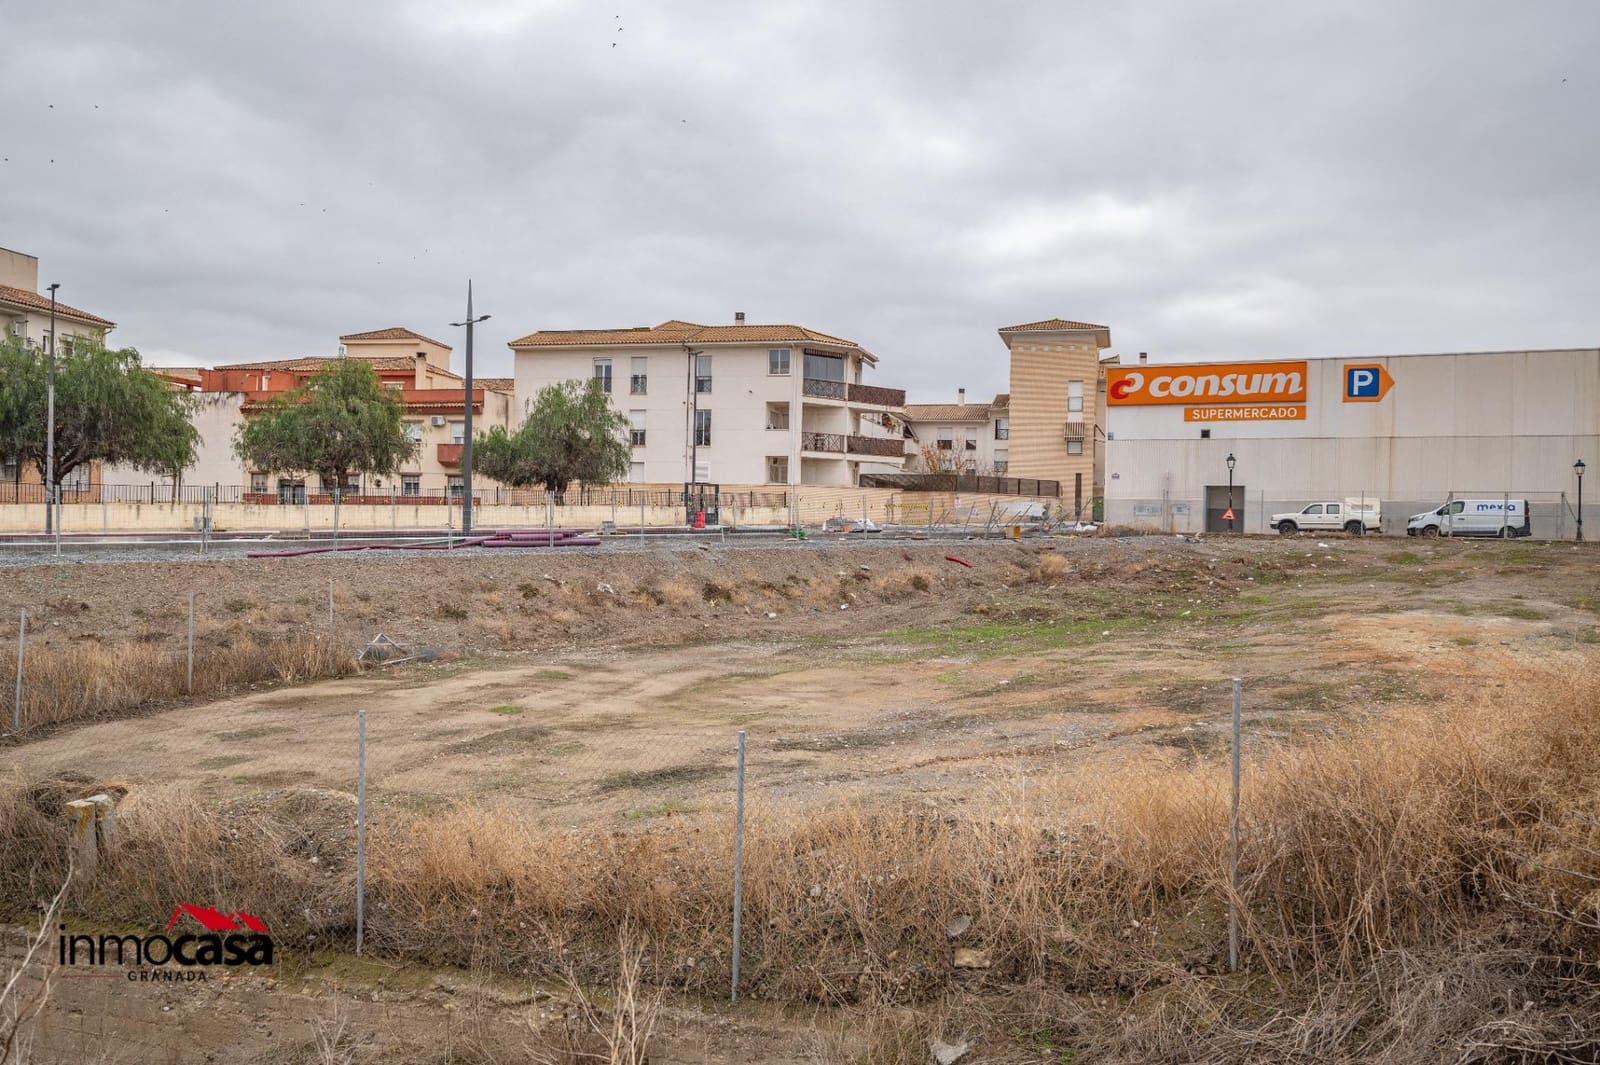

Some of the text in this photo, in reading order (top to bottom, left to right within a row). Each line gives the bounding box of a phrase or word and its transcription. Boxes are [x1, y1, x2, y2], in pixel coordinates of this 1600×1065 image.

[1149, 371, 1303, 397] consum
[1353, 370, 1373, 395] P
[1192, 407, 1297, 420] SUPERMERCADO
